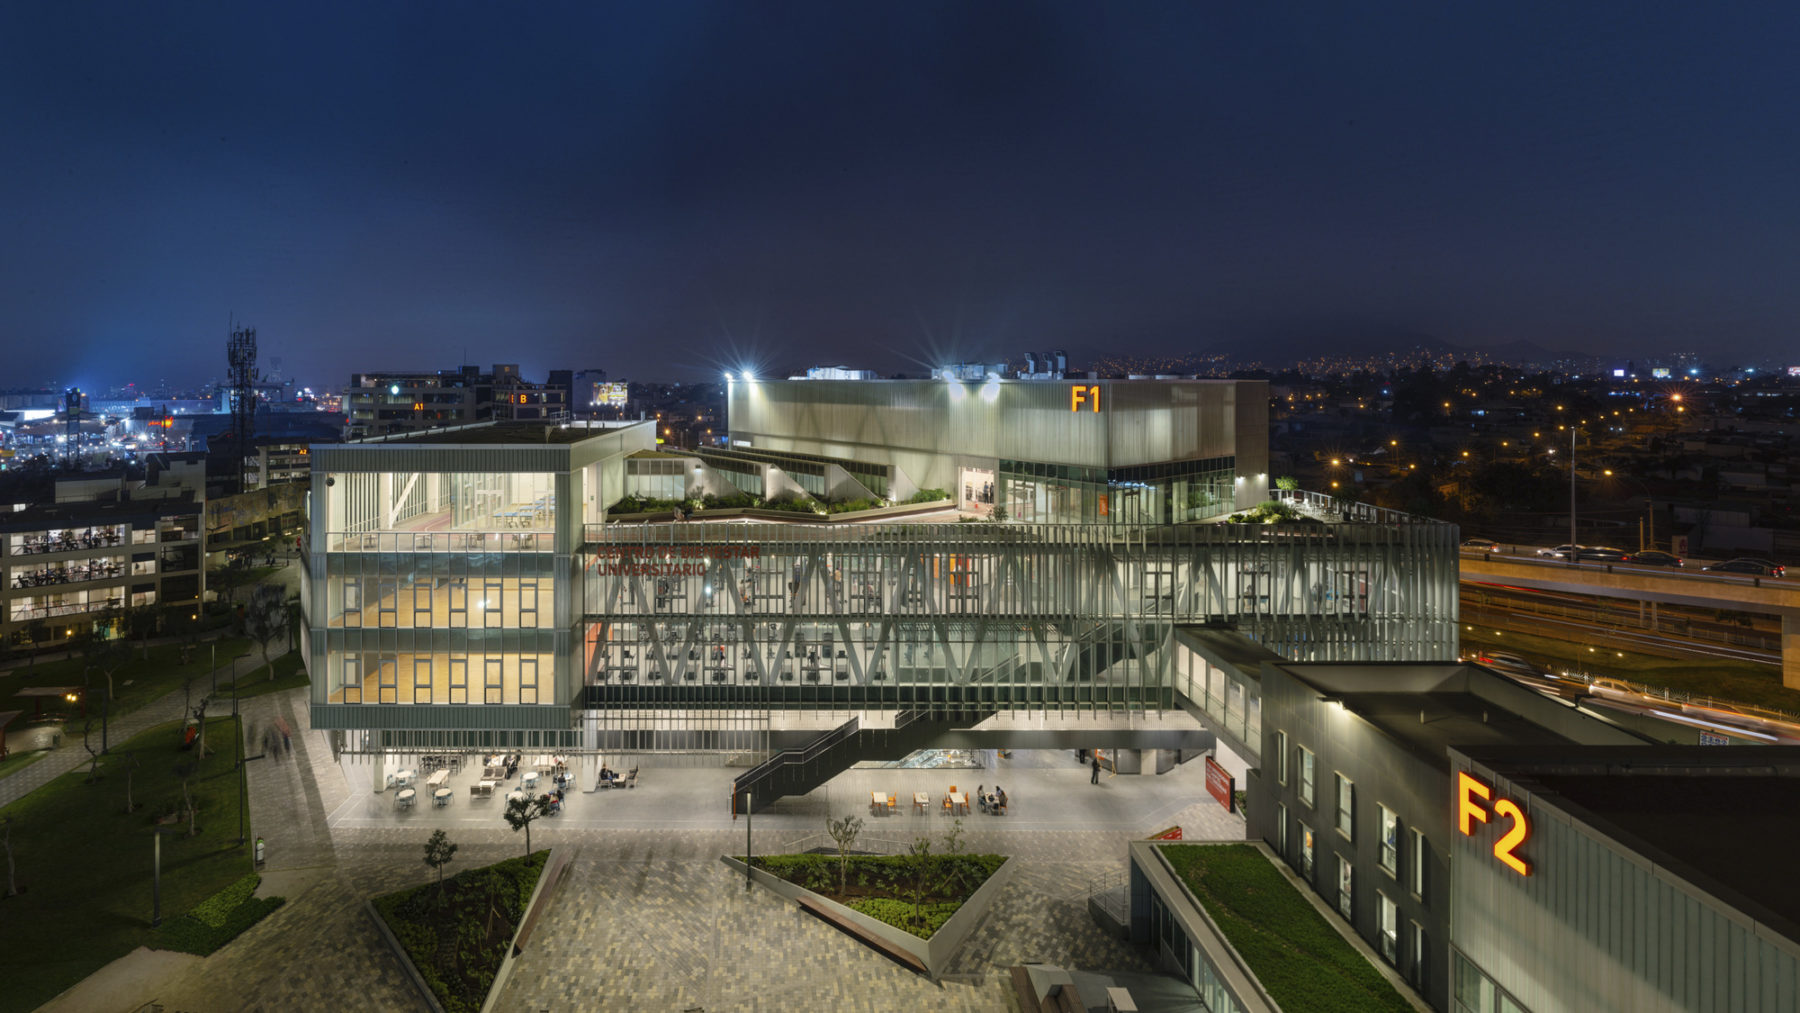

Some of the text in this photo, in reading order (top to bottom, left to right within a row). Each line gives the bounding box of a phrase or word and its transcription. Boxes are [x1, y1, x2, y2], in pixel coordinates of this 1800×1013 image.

[520, 394, 527, 404] B
[1072, 385, 1100, 413] F1
[597, 545, 760, 559] CENTRO DE BIENESTAR
[598, 563, 706, 577] UNIVERSITARIO
[1458, 771, 1531, 876] F2
